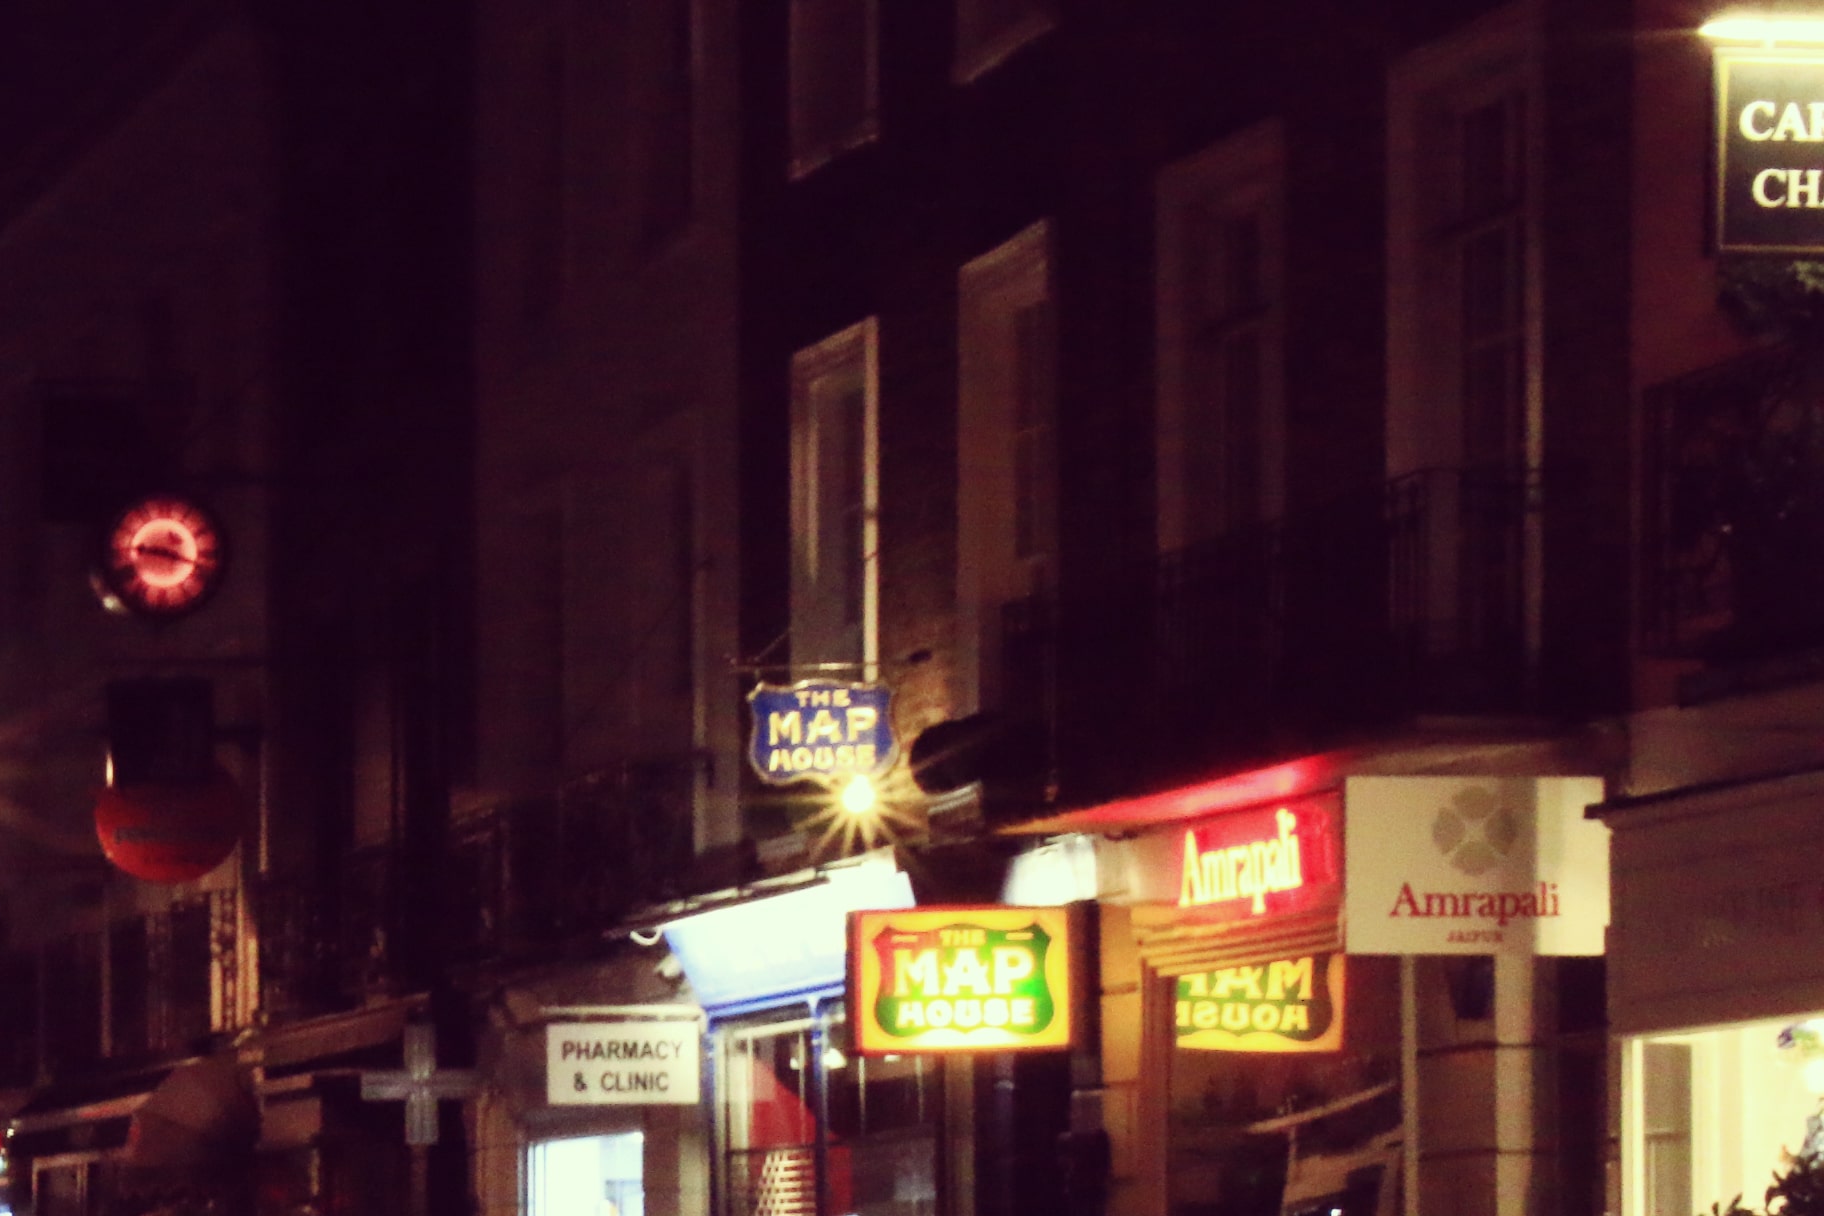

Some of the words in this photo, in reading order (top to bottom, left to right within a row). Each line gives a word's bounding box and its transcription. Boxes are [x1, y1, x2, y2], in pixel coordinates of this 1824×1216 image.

[1751, 166, 1824, 209] CH
[794, 688, 851, 707] THE
[768, 706, 878, 746] MAP
[768, 744, 877, 772] HOUSE
[1178, 808, 1303, 914] Amrapali
[1388, 881, 1561, 927] Amrapali
[938, 928, 987, 946] THE
[892, 946, 1035, 997] MAP
[894, 997, 1036, 1029] HOUSE
[561, 1039, 683, 1061] PHARMACY
[573, 1071, 588, 1092] &
[600, 1071, 670, 1092] CLINIC
